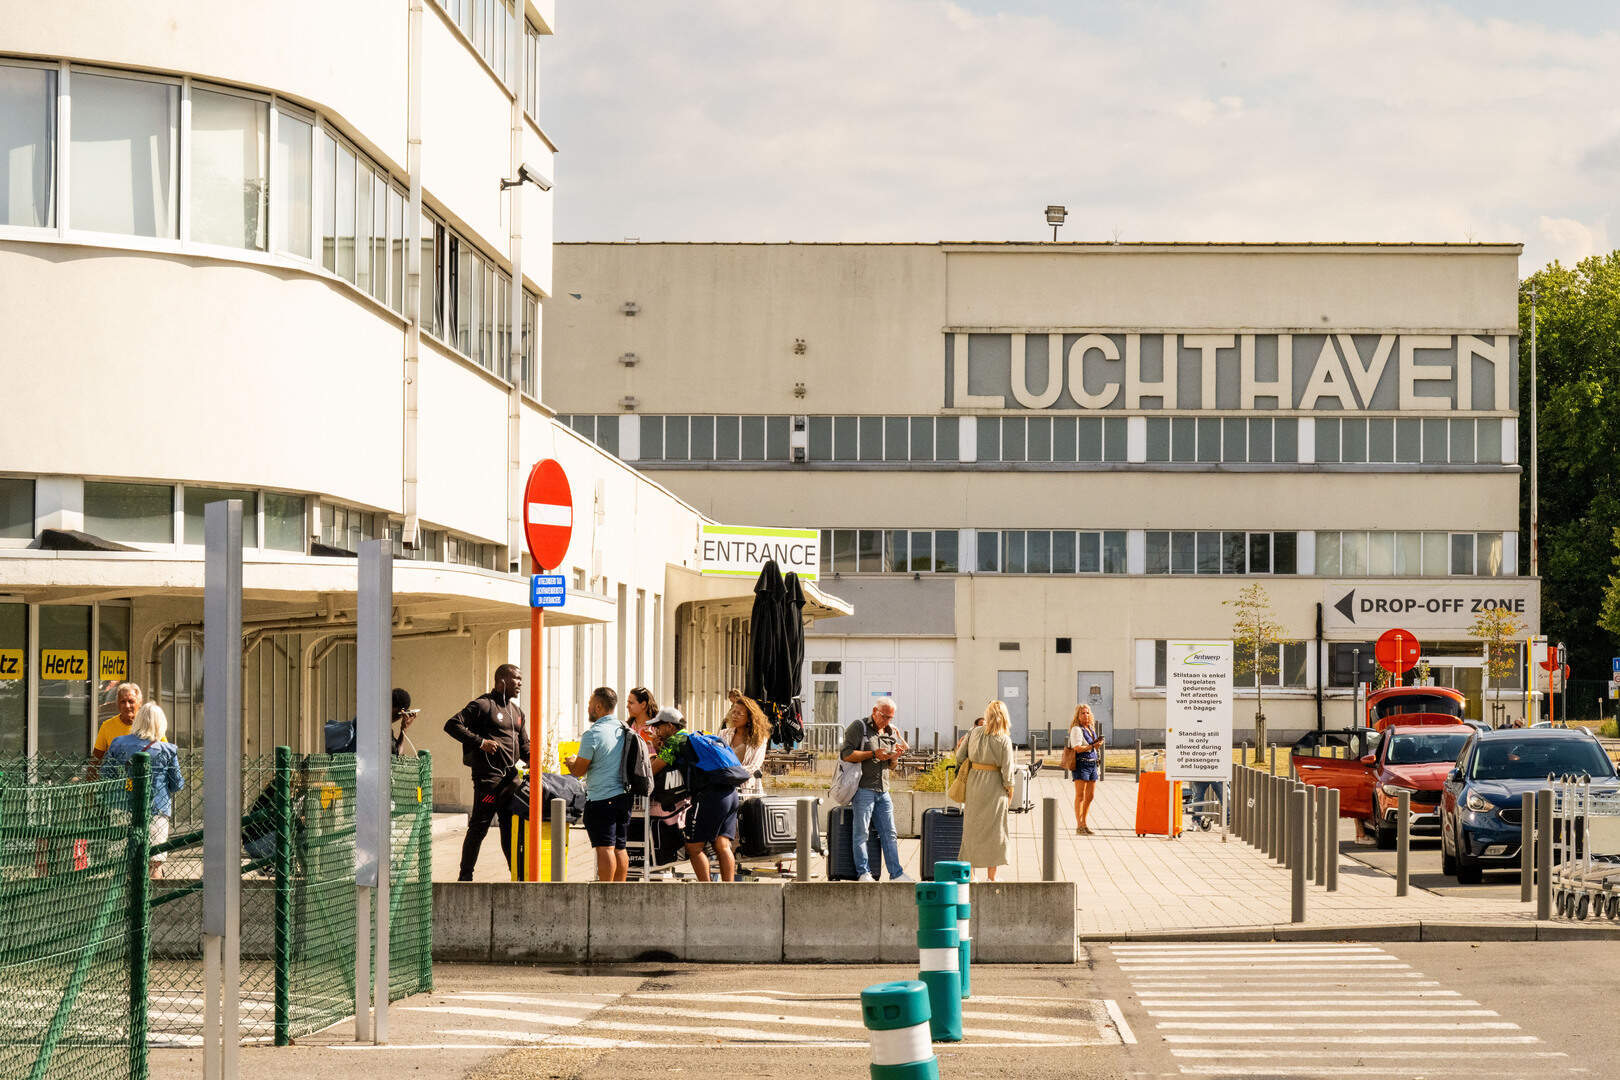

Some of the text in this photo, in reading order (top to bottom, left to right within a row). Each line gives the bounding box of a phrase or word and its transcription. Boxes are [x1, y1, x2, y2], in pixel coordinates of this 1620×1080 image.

[953, 333, 1510, 410] LUCHTHAVEN
[703, 540, 816, 566] ENTRANCE
[1360, 598, 1525, 613] DROP-OFF ZONE
[45, 654, 84, 674] Hertz
[102, 655, 125, 675] Hertz
[1193, 654, 1221, 662] Antwerp
